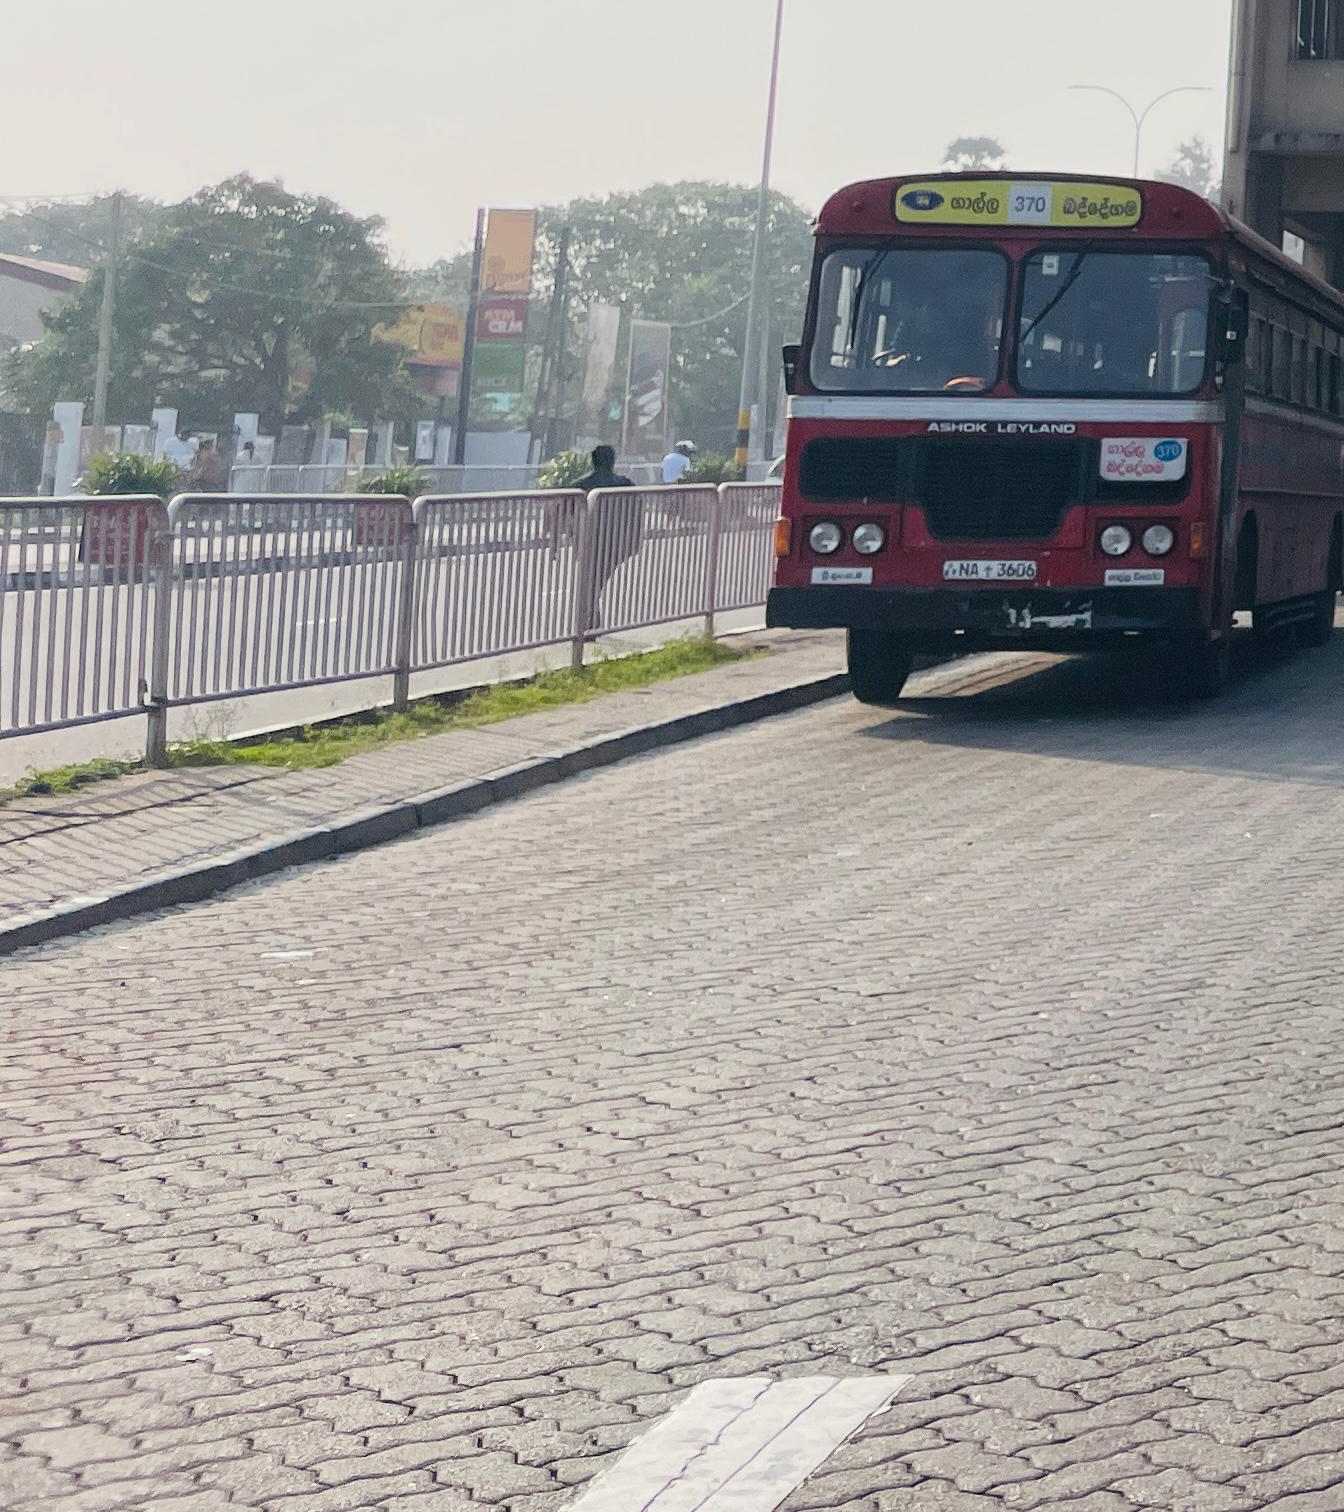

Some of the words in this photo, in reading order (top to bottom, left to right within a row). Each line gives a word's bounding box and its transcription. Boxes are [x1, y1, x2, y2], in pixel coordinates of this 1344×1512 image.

[951, 192, 1000, 214] ගාල්ල
[1014, 196, 1047, 212] 370
[927, 422, 987, 433] ASHOK
[997, 423, 1076, 434] LEYLAND
